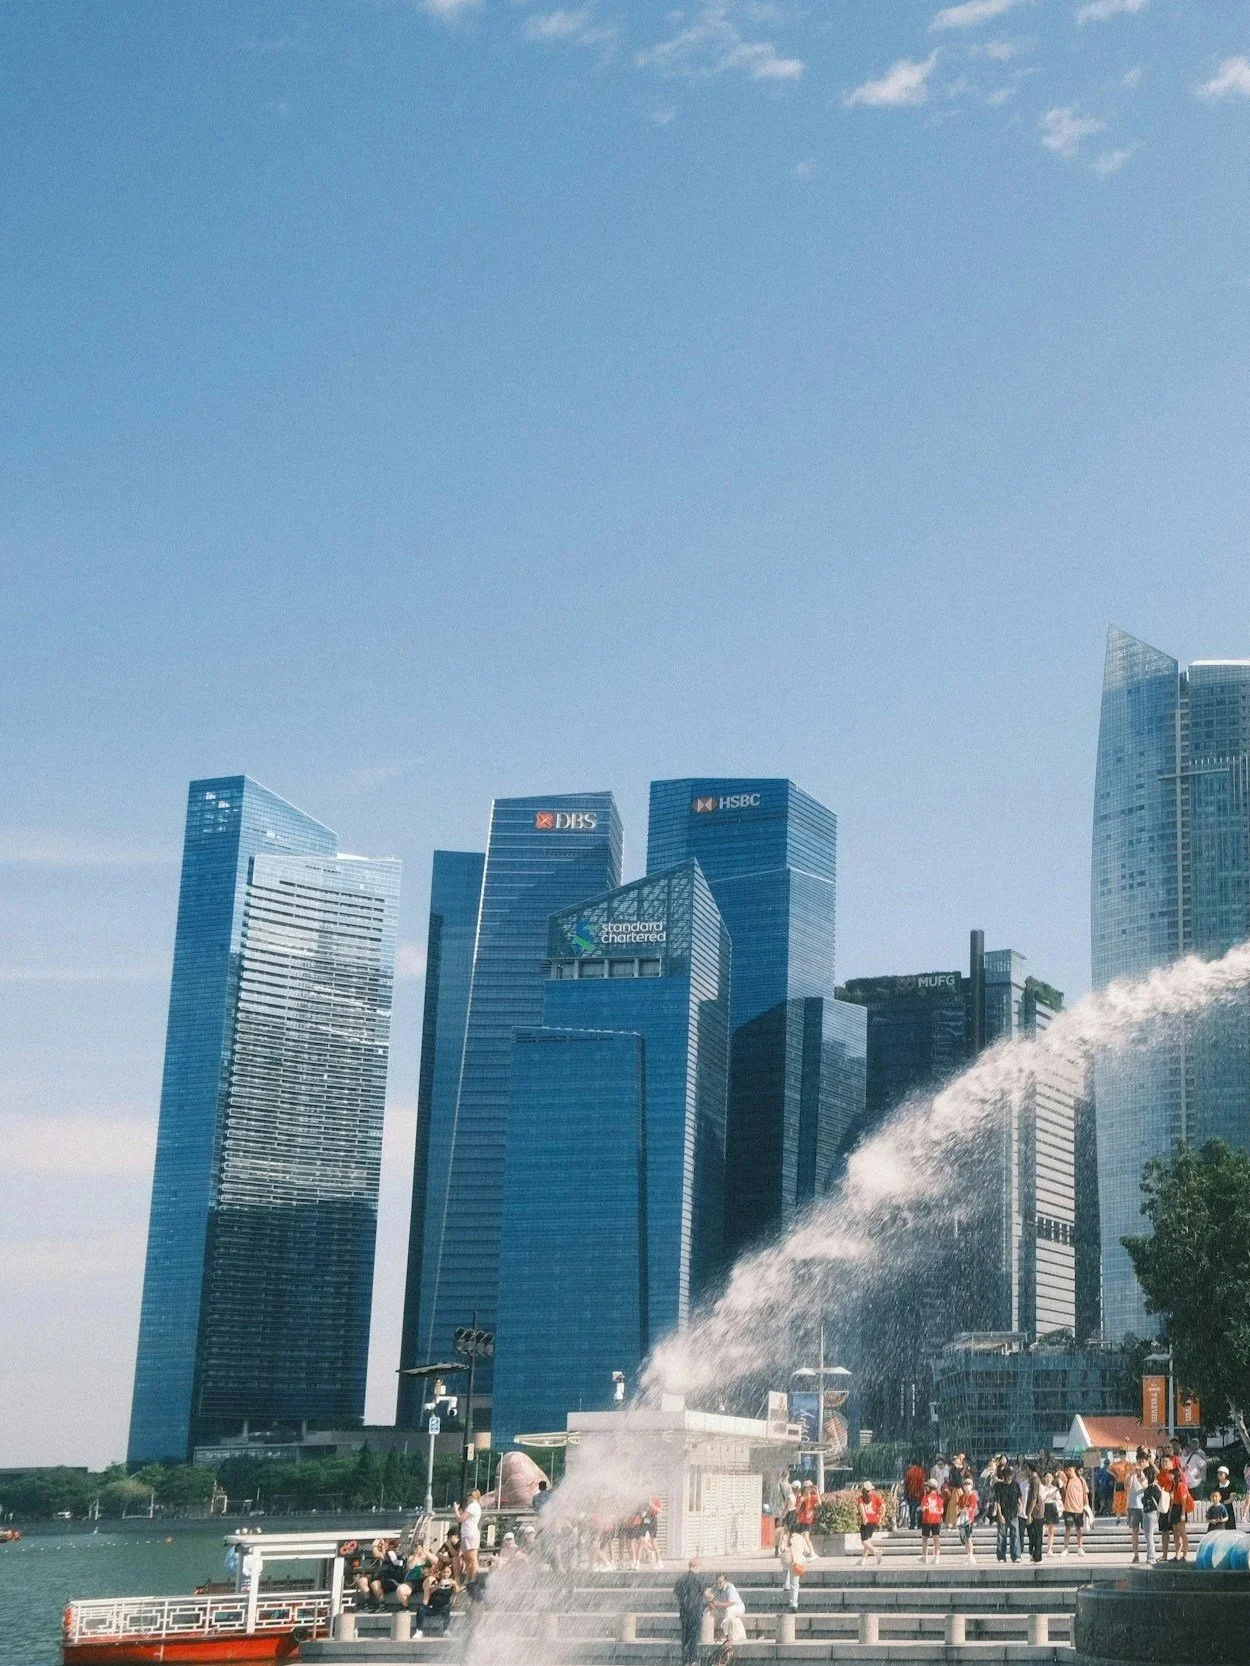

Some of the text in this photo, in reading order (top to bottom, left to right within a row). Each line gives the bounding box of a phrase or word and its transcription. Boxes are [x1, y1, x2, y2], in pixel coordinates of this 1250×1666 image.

[719, 793, 761, 809] HSBC
[556, 812, 597, 829] DBS
[601, 920, 663, 933] standard
[601, 931, 667, 944] chartered
[918, 975, 956, 988] MUFG
